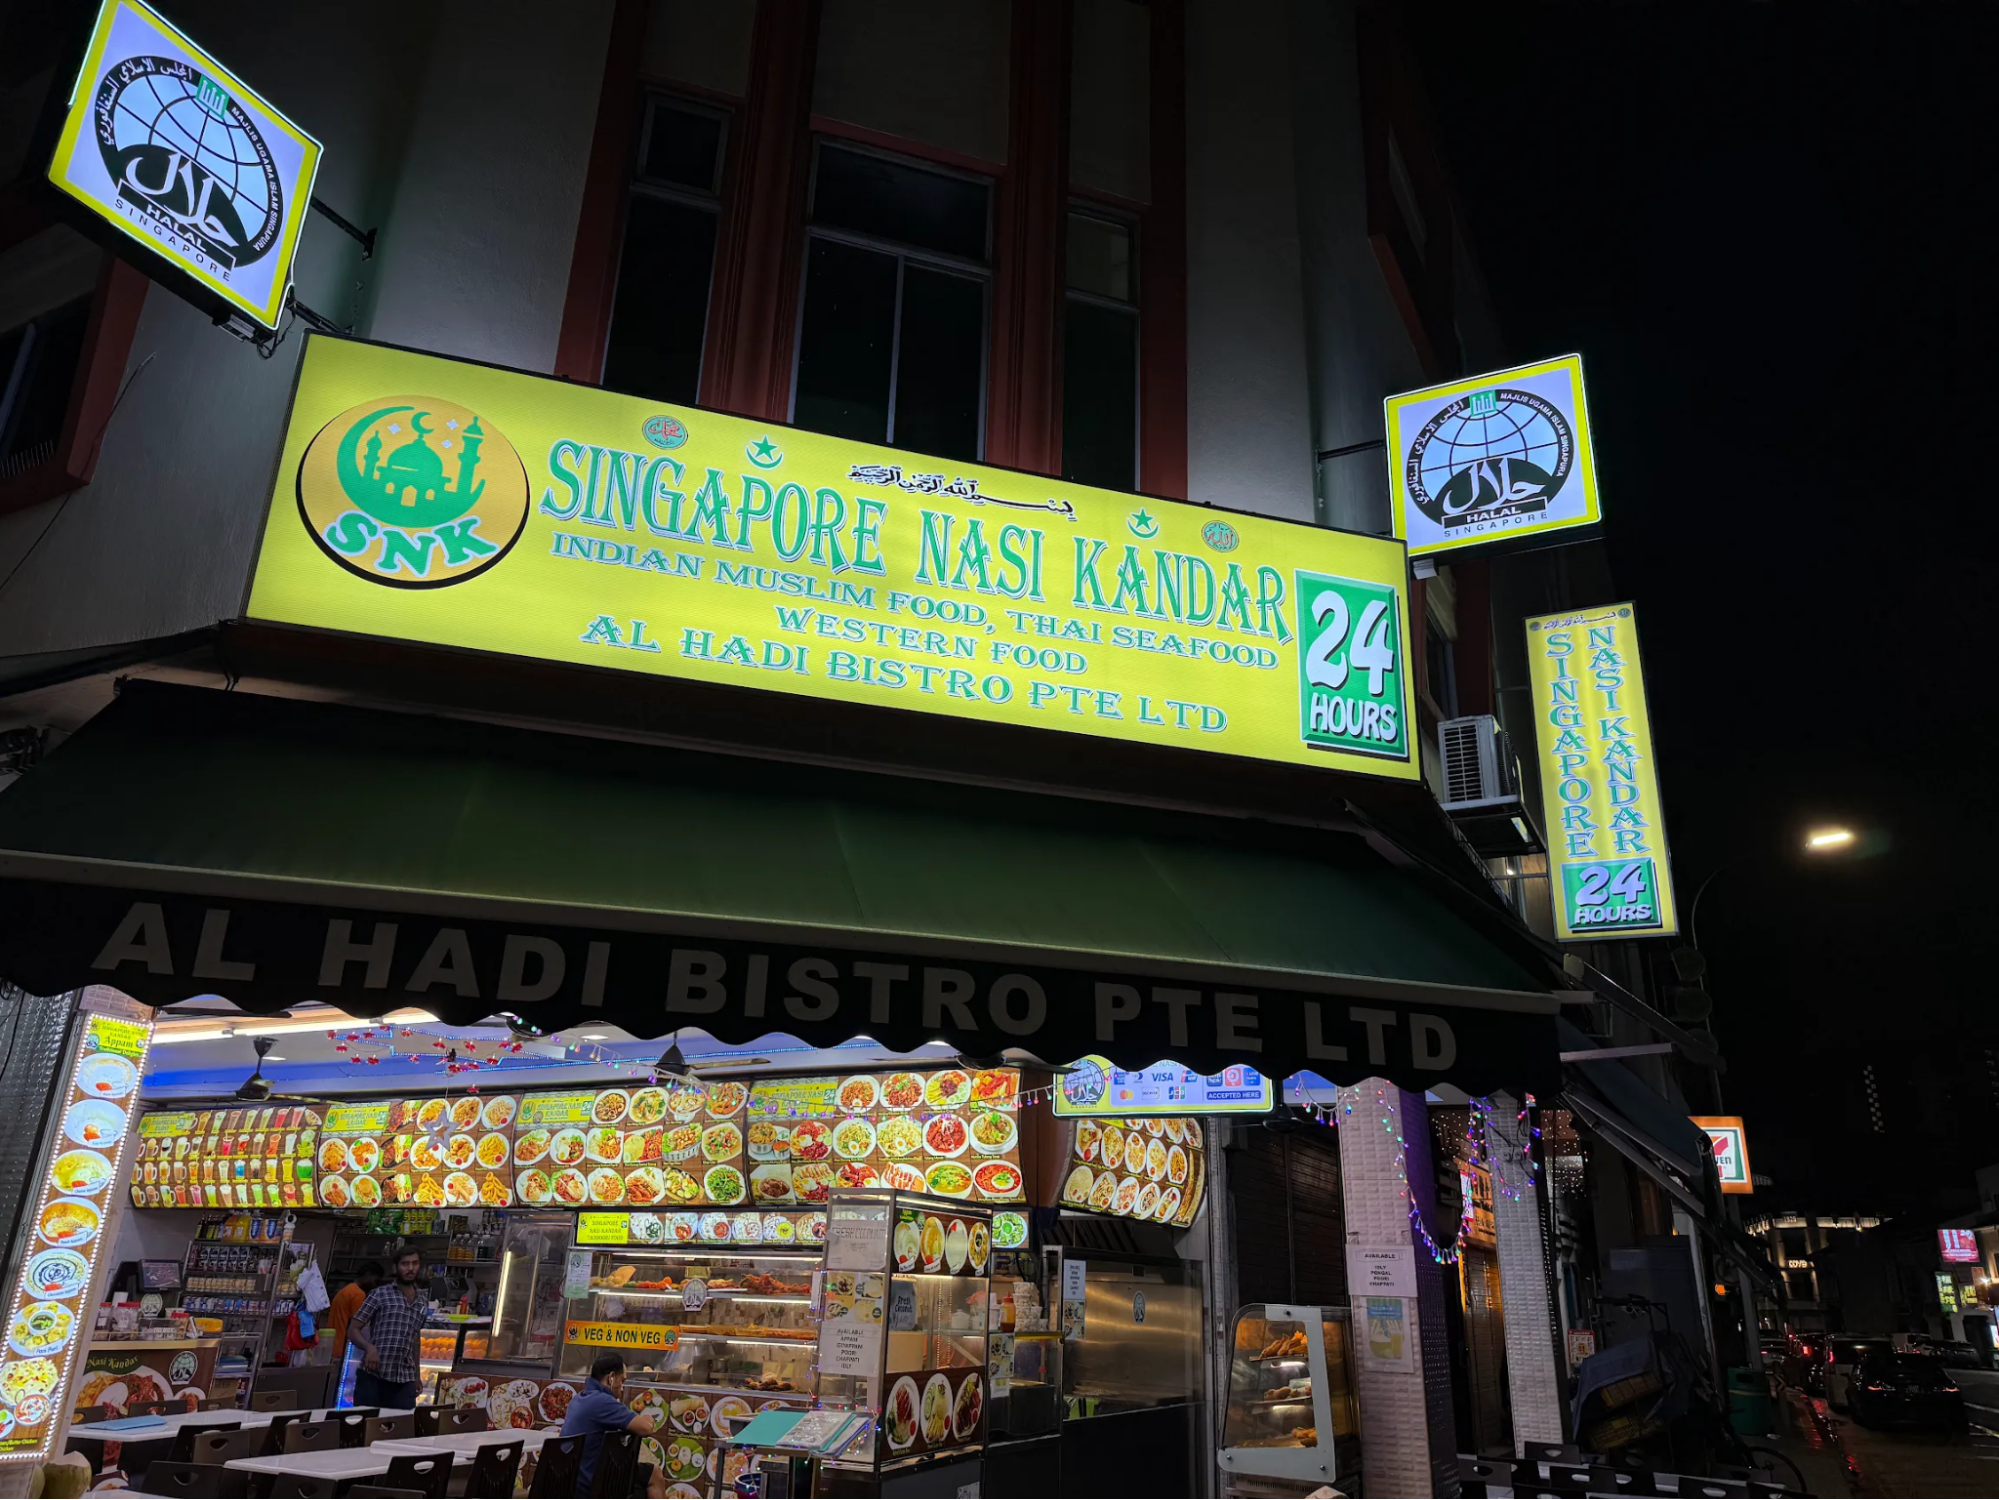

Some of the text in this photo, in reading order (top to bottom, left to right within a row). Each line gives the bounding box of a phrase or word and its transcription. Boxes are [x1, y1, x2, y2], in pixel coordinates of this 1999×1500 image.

[230, 106, 279, 252] MAJLIS UGAMA ISLAM SINGAPURA
[115, 199, 231, 282] SINGAPORE
[146, 204, 207, 253] HALAL
[1500, 392, 1570, 477] MAJLIS UGAMA ISLAM SINGAPURA
[323, 510, 499, 578] SNK
[539, 437, 1294, 645] SINGAPORE NASI KANDAR
[1444, 511, 1548, 537] SINGAPORE
[1466, 506, 1522, 523] HALAL
[551, 531, 1279, 669] INDIAN MUSLIM FOOD, THAI SEAFOOD
[579, 614, 1229, 733] AL HADI BISTRO PTE LTD
[775, 605, 1088, 675] WESTERN FOOD
[1305, 590, 1395, 697] 24
[1308, 694, 1399, 743] HOURS
[1546, 632, 1599, 858] SINGAPORE
[1588, 625, 1652, 855] NASI KANDAR
[1575, 863, 1648, 906] 24
[1575, 903, 1653, 925] HOURS
[92, 902, 1458, 1070] AL HADI BISTRO PTE LTD
[104, 1035, 133, 1048] Appam
[1151, 1072, 1174, 1082] VISA
[87, 1355, 138, 1370] Nasi Kandar
[584, 1328, 661, 1344] VEG & NON VEG
